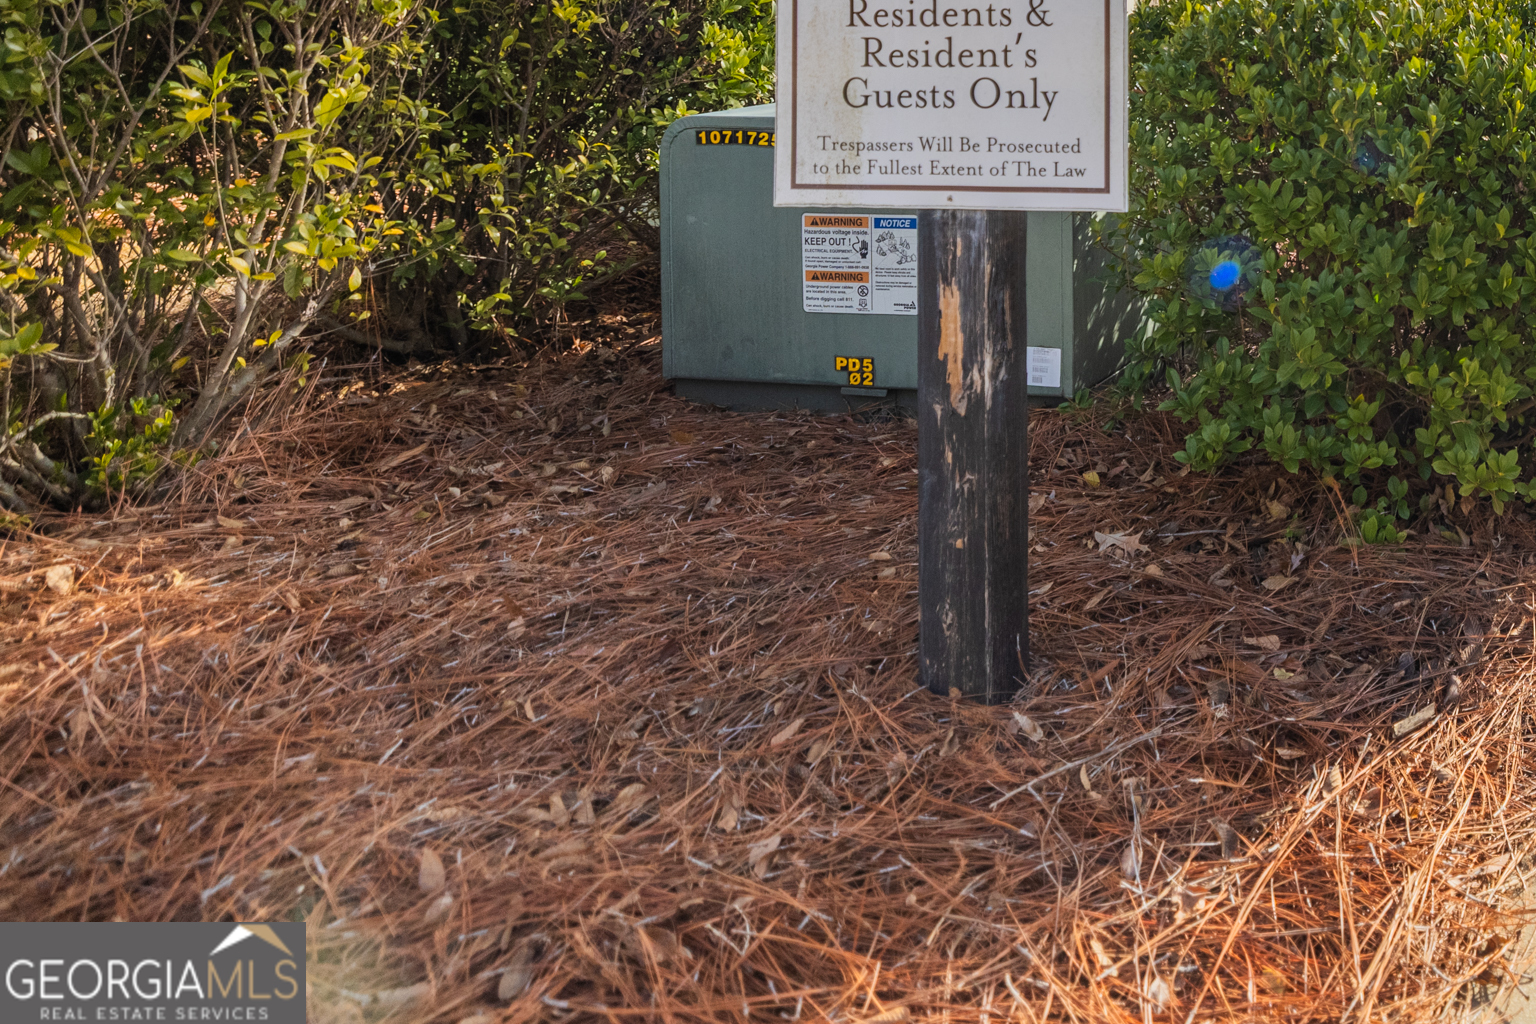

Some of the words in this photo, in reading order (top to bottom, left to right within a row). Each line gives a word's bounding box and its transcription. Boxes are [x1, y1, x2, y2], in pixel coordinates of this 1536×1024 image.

[861, 32, 1037, 68] Resident's
[842, 77, 955, 109] Guests
[969, 77, 1059, 122] Only
[817, 135, 913, 156] Trespassers
[918, 136, 953, 152] Will
[959, 137, 980, 153] Be
[986, 137, 1081, 154] Prosecuted
[813, 162, 829, 175] to
[835, 160, 861, 175] the
[867, 160, 923, 175] Fullest
[929, 161, 984, 176] Extent
[989, 160, 1008, 177] of
[1012, 161, 1047, 177] The
[1053, 162, 1087, 177] Law
[819, 218, 863, 226] WARNING
[880, 219, 911, 228] NOTICE
[804, 237, 827, 246] KEEP
[828, 237, 846, 246] OUT
[820, 272, 864, 282] WARNING
[835, 356, 873, 372] PD5
